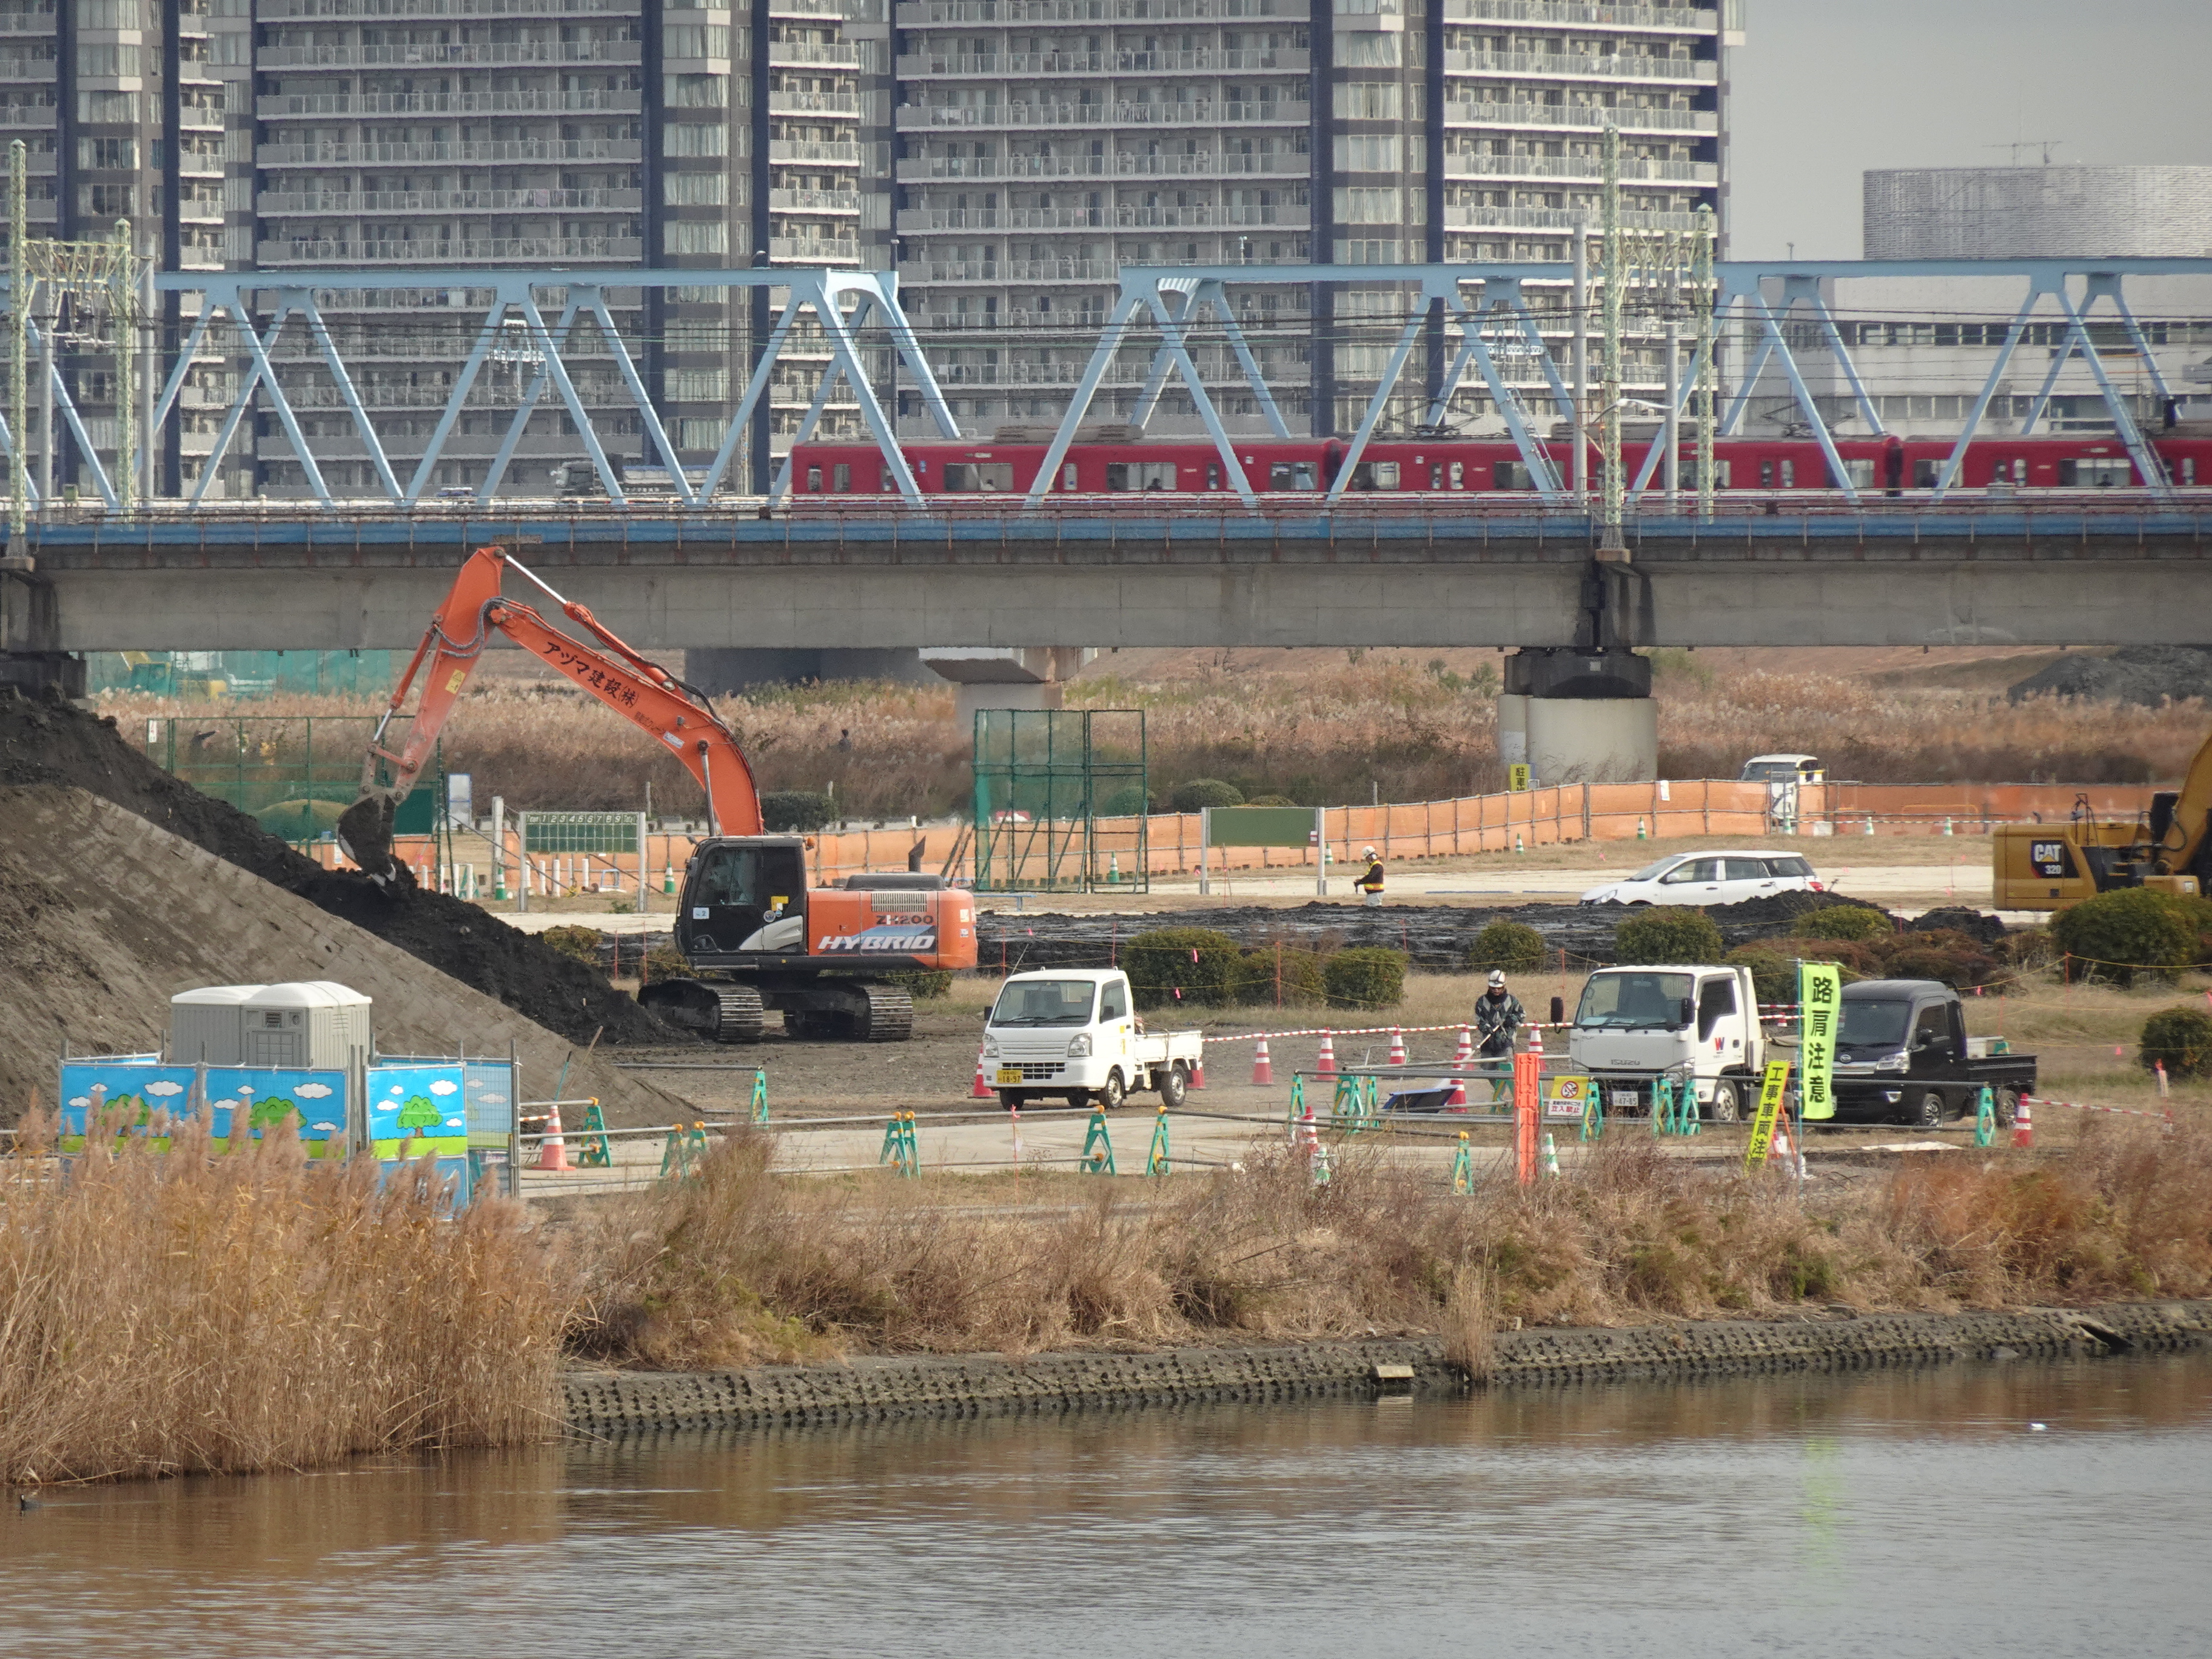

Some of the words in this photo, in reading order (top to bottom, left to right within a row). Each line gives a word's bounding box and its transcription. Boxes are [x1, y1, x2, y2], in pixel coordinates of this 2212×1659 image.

[2034, 844, 2061, 862] CAT
[2045, 865, 2061, 874] 320
[876, 915, 934, 925] ZH200
[817, 936, 936, 950] HYBRID
[1808, 976, 1834, 1103] 路肩注意
